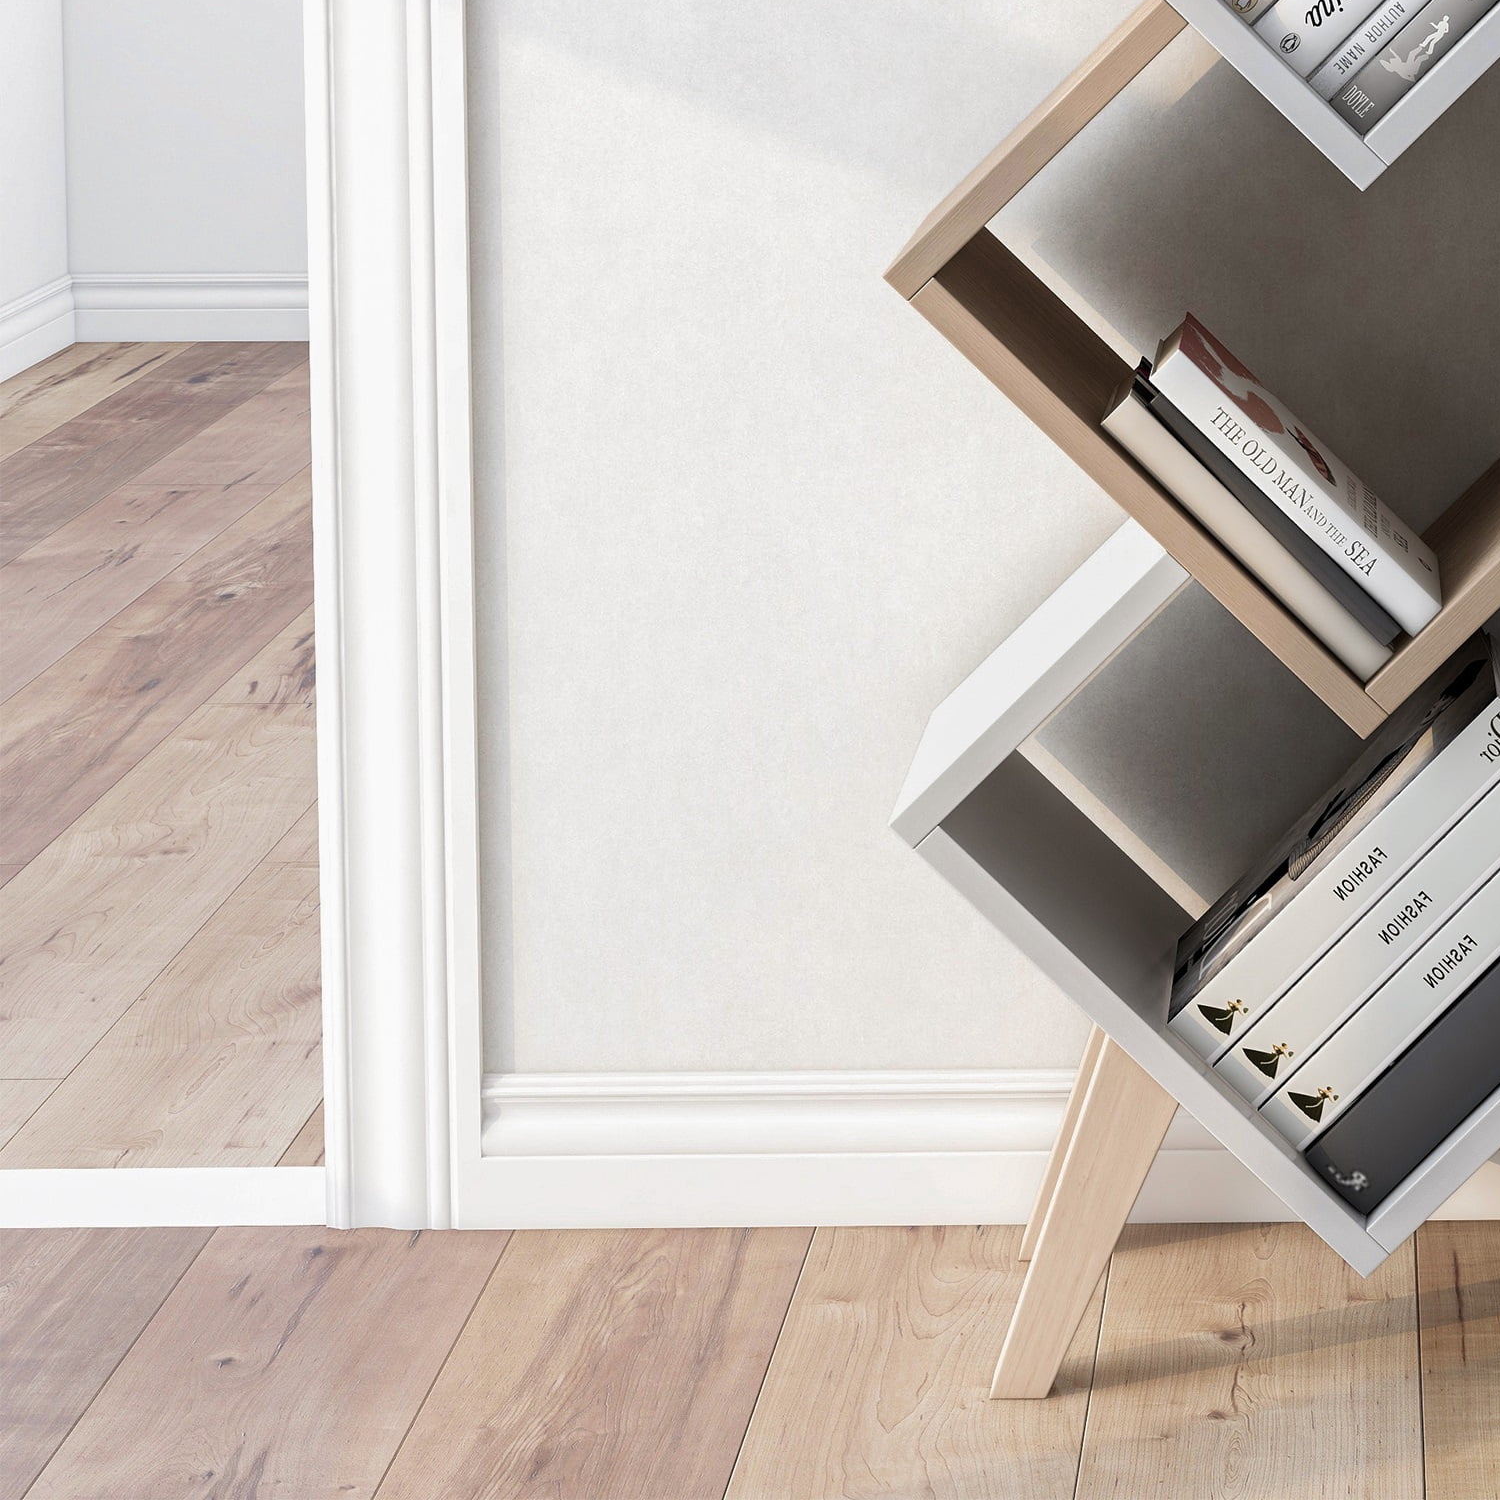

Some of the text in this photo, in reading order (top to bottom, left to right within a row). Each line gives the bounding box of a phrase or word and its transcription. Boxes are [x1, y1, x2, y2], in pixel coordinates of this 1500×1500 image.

[1333, 1, 1406, 75] AUTHOR NAME
[1342, 85, 1375, 118] DOYLE
[1210, 407, 1247, 446] THE
[1242, 439, 1278, 475] OLD
[1272, 469, 1314, 509] MAN
[1303, 505, 1327, 527] AND
[1324, 523, 1348, 547] THE
[1344, 540, 1378, 577] SEA
